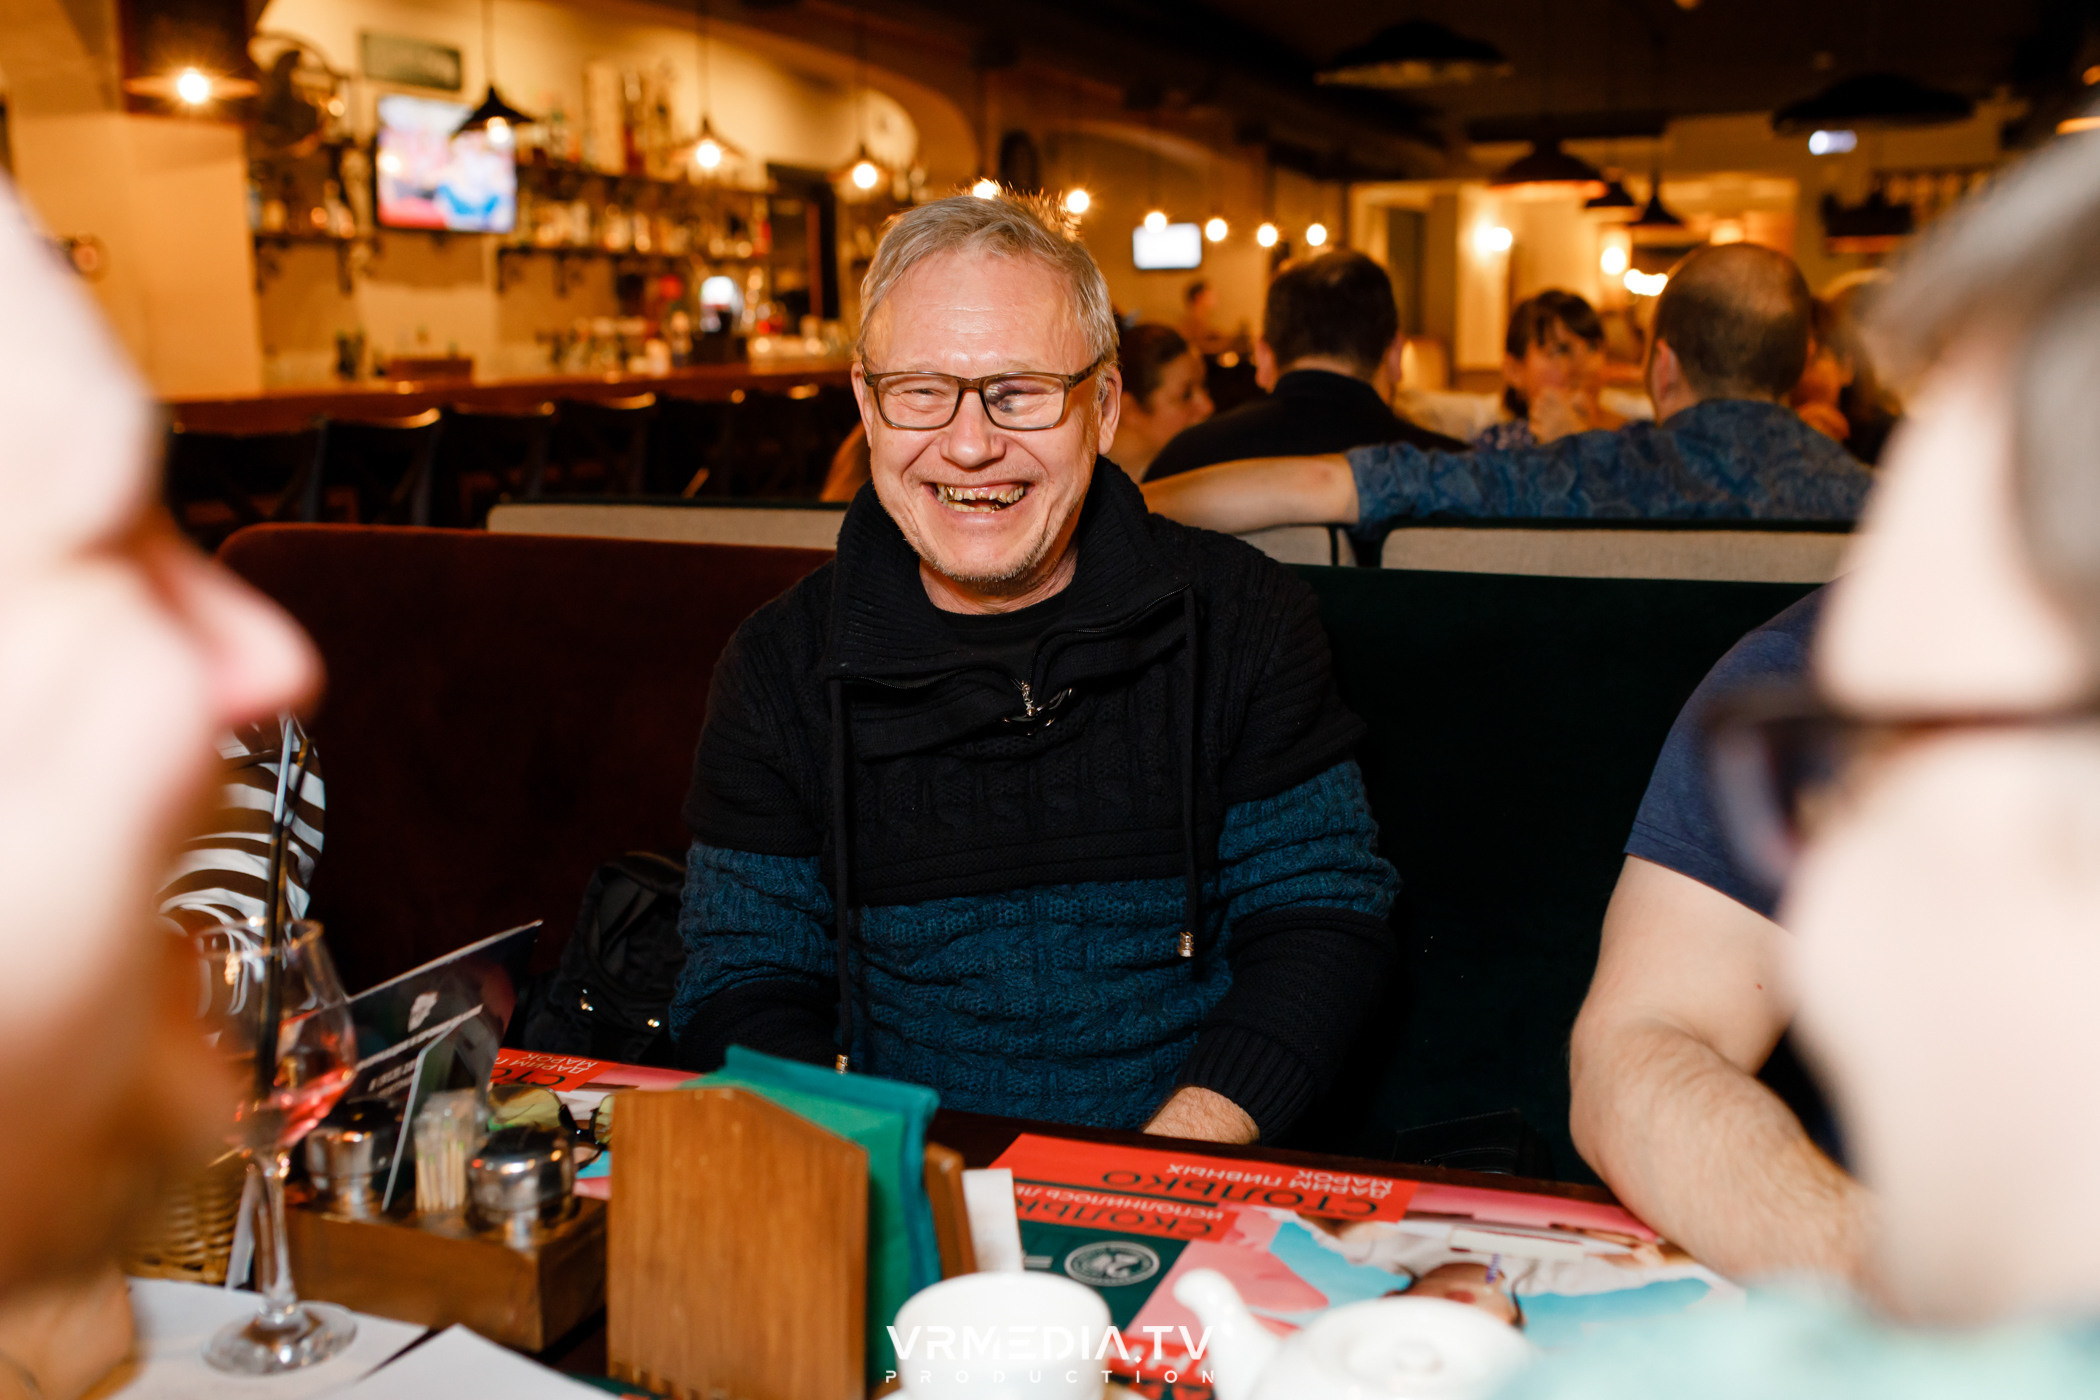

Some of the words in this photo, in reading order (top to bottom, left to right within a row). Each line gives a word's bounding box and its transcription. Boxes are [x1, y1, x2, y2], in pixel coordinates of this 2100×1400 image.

[509, 1059, 591, 1074] ДАРИМ
[522, 1053, 598, 1068] МАРОК
[1166, 1164, 1283, 1187] ПИВНЫХ
[1297, 1169, 1394, 1194] МАРОК
[1102, 1170, 1378, 1216] СТОЛЬКО
[1289, 1178, 1392, 1199] ДАРИМ
[1046, 1189, 1224, 1221] ИСПОЛНИЛОСЬ
